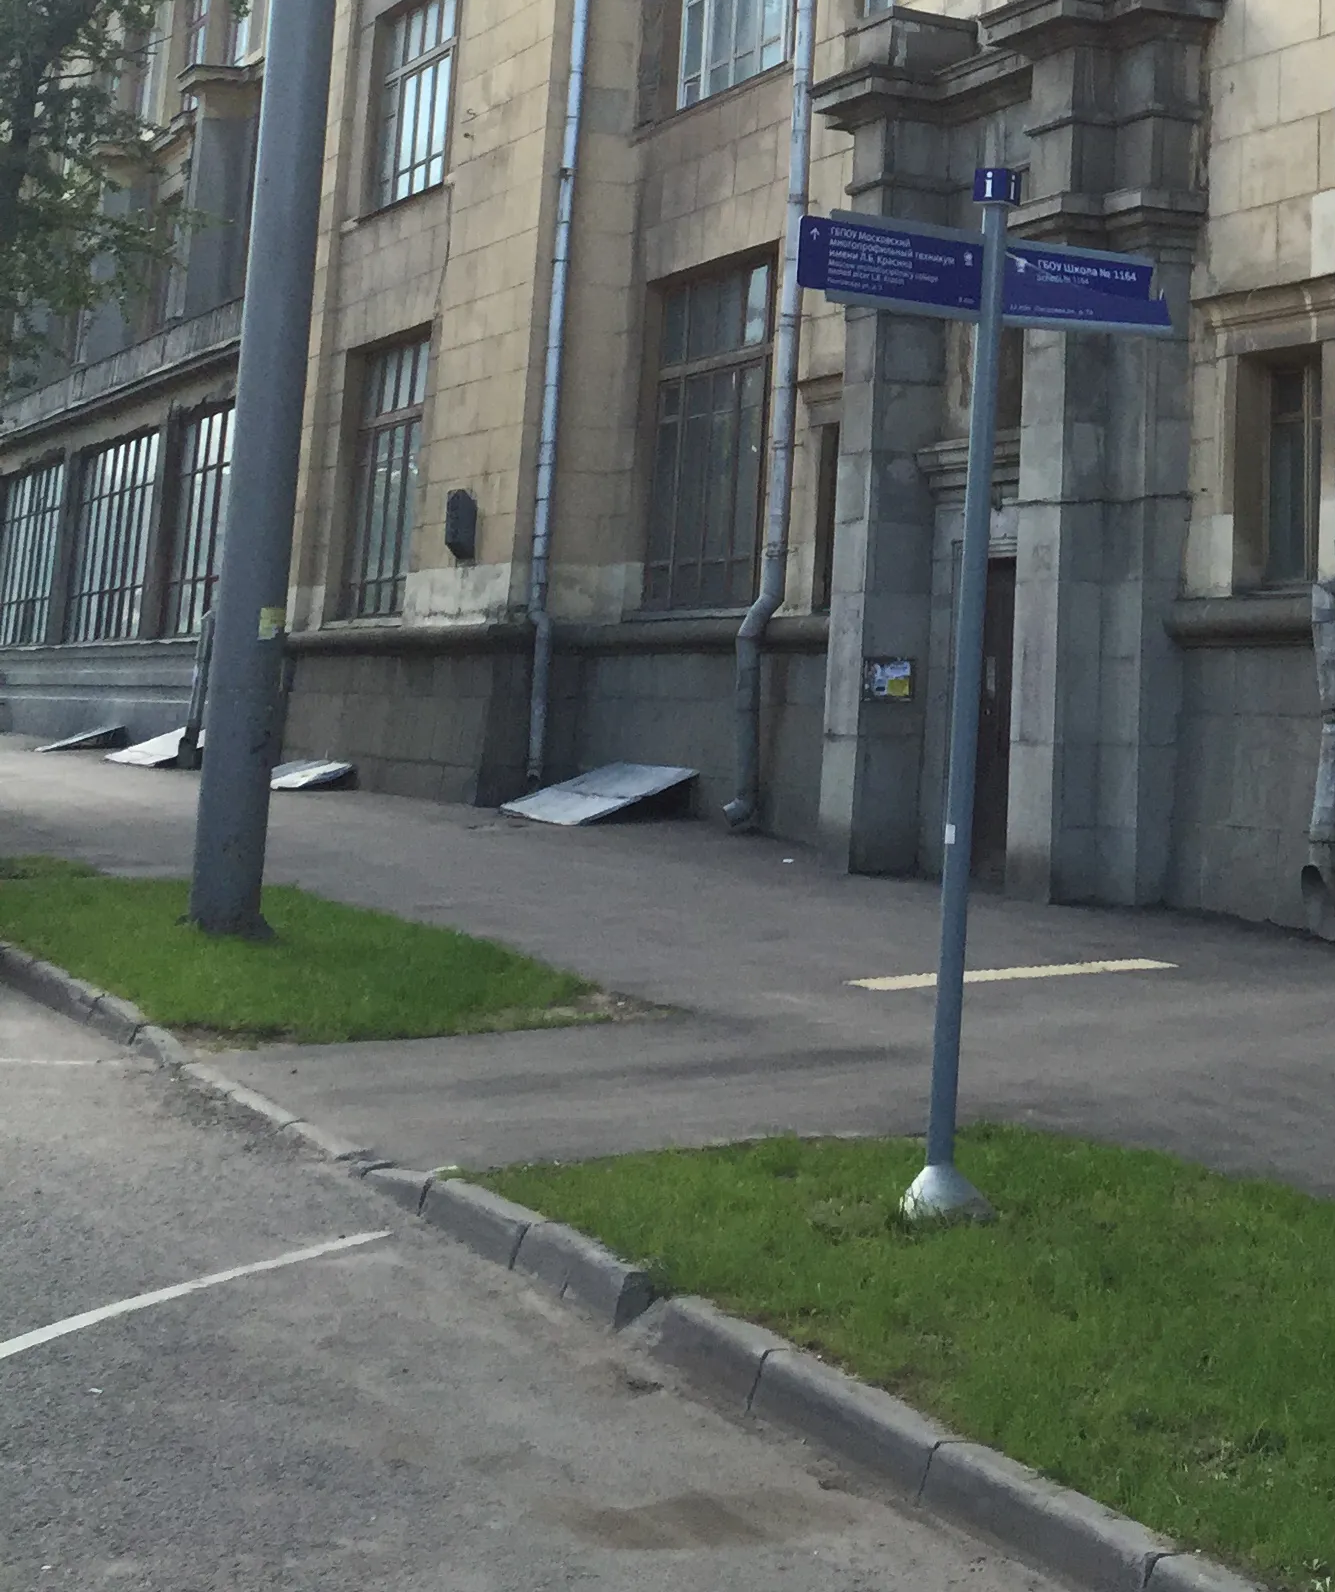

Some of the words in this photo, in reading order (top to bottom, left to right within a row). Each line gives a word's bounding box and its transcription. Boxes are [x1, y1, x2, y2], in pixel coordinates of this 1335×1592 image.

[830, 226, 856, 240] ГБПОУ
[858, 233, 911, 248] Московский
[829, 238, 913, 258] многопрофильный
[915, 251, 955, 267] техникум
[829, 250, 858, 261] имени
[877, 255, 913, 269] Красина
[1037, 259, 1062, 271] ГБОУ
[1063, 264, 1098, 277] Школа
[1099, 268, 1111, 279] №
[1114, 271, 1137, 282] 1164
